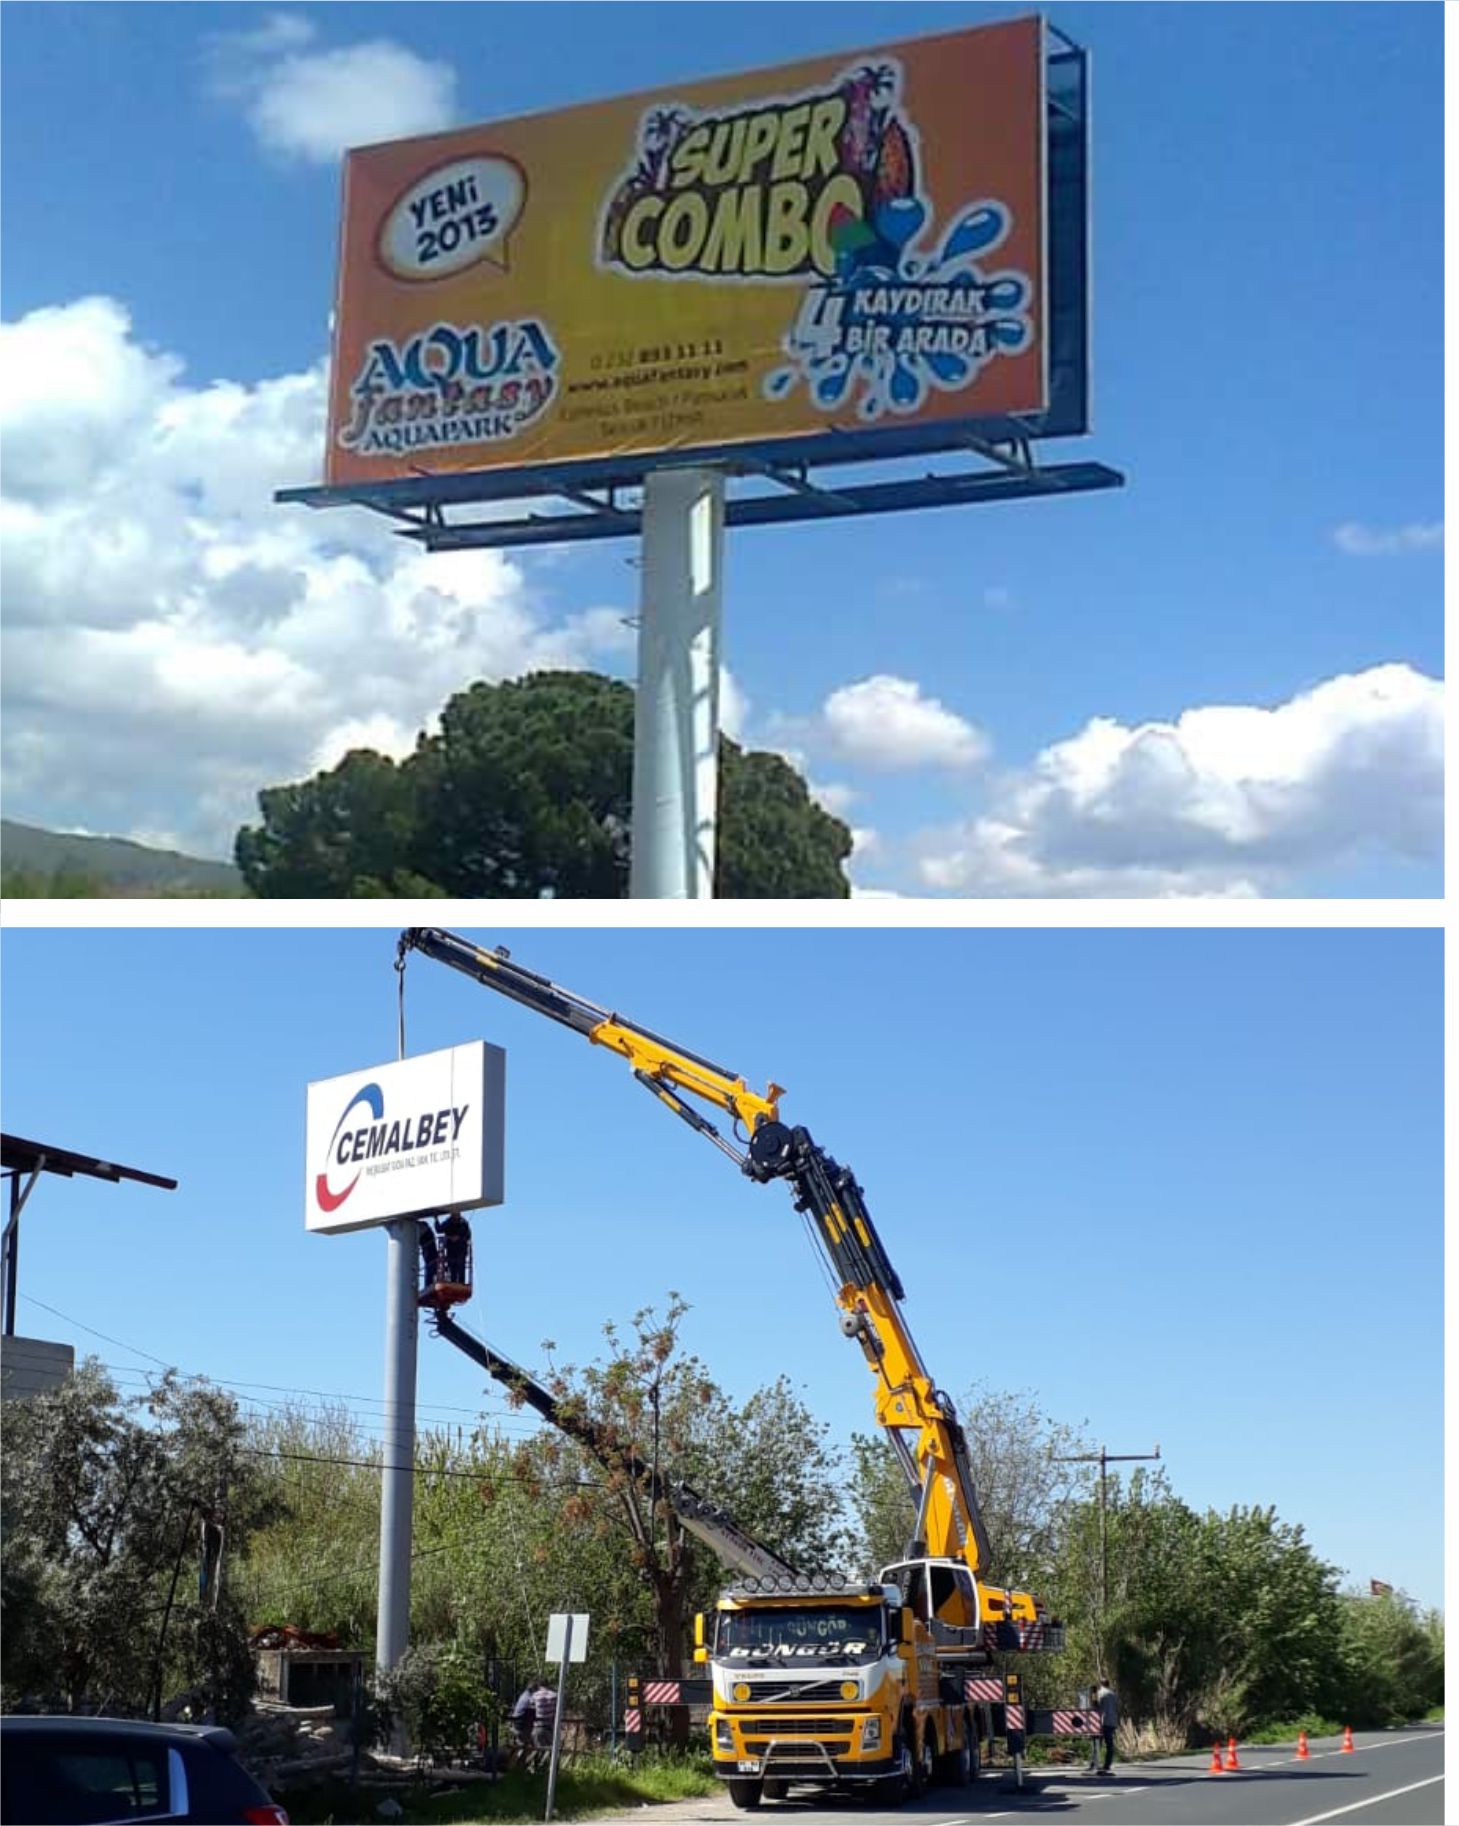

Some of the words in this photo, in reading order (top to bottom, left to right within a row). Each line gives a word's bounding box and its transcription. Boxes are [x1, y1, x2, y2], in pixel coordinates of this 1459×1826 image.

[671, 96, 847, 187] SUPER
[409, 174, 479, 228] YENİ
[619, 174, 863, 274] COMBO
[416, 204, 499, 264] 2013
[853, 288, 986, 315] KAYDIRAK
[354, 322, 557, 393] AQUA
[847, 319, 892, 354] BİR
[897, 326, 988, 355] ARADA
[364, 415, 514, 452] AQUAPARK
[337, 1103, 470, 1166] CEMALBEY
